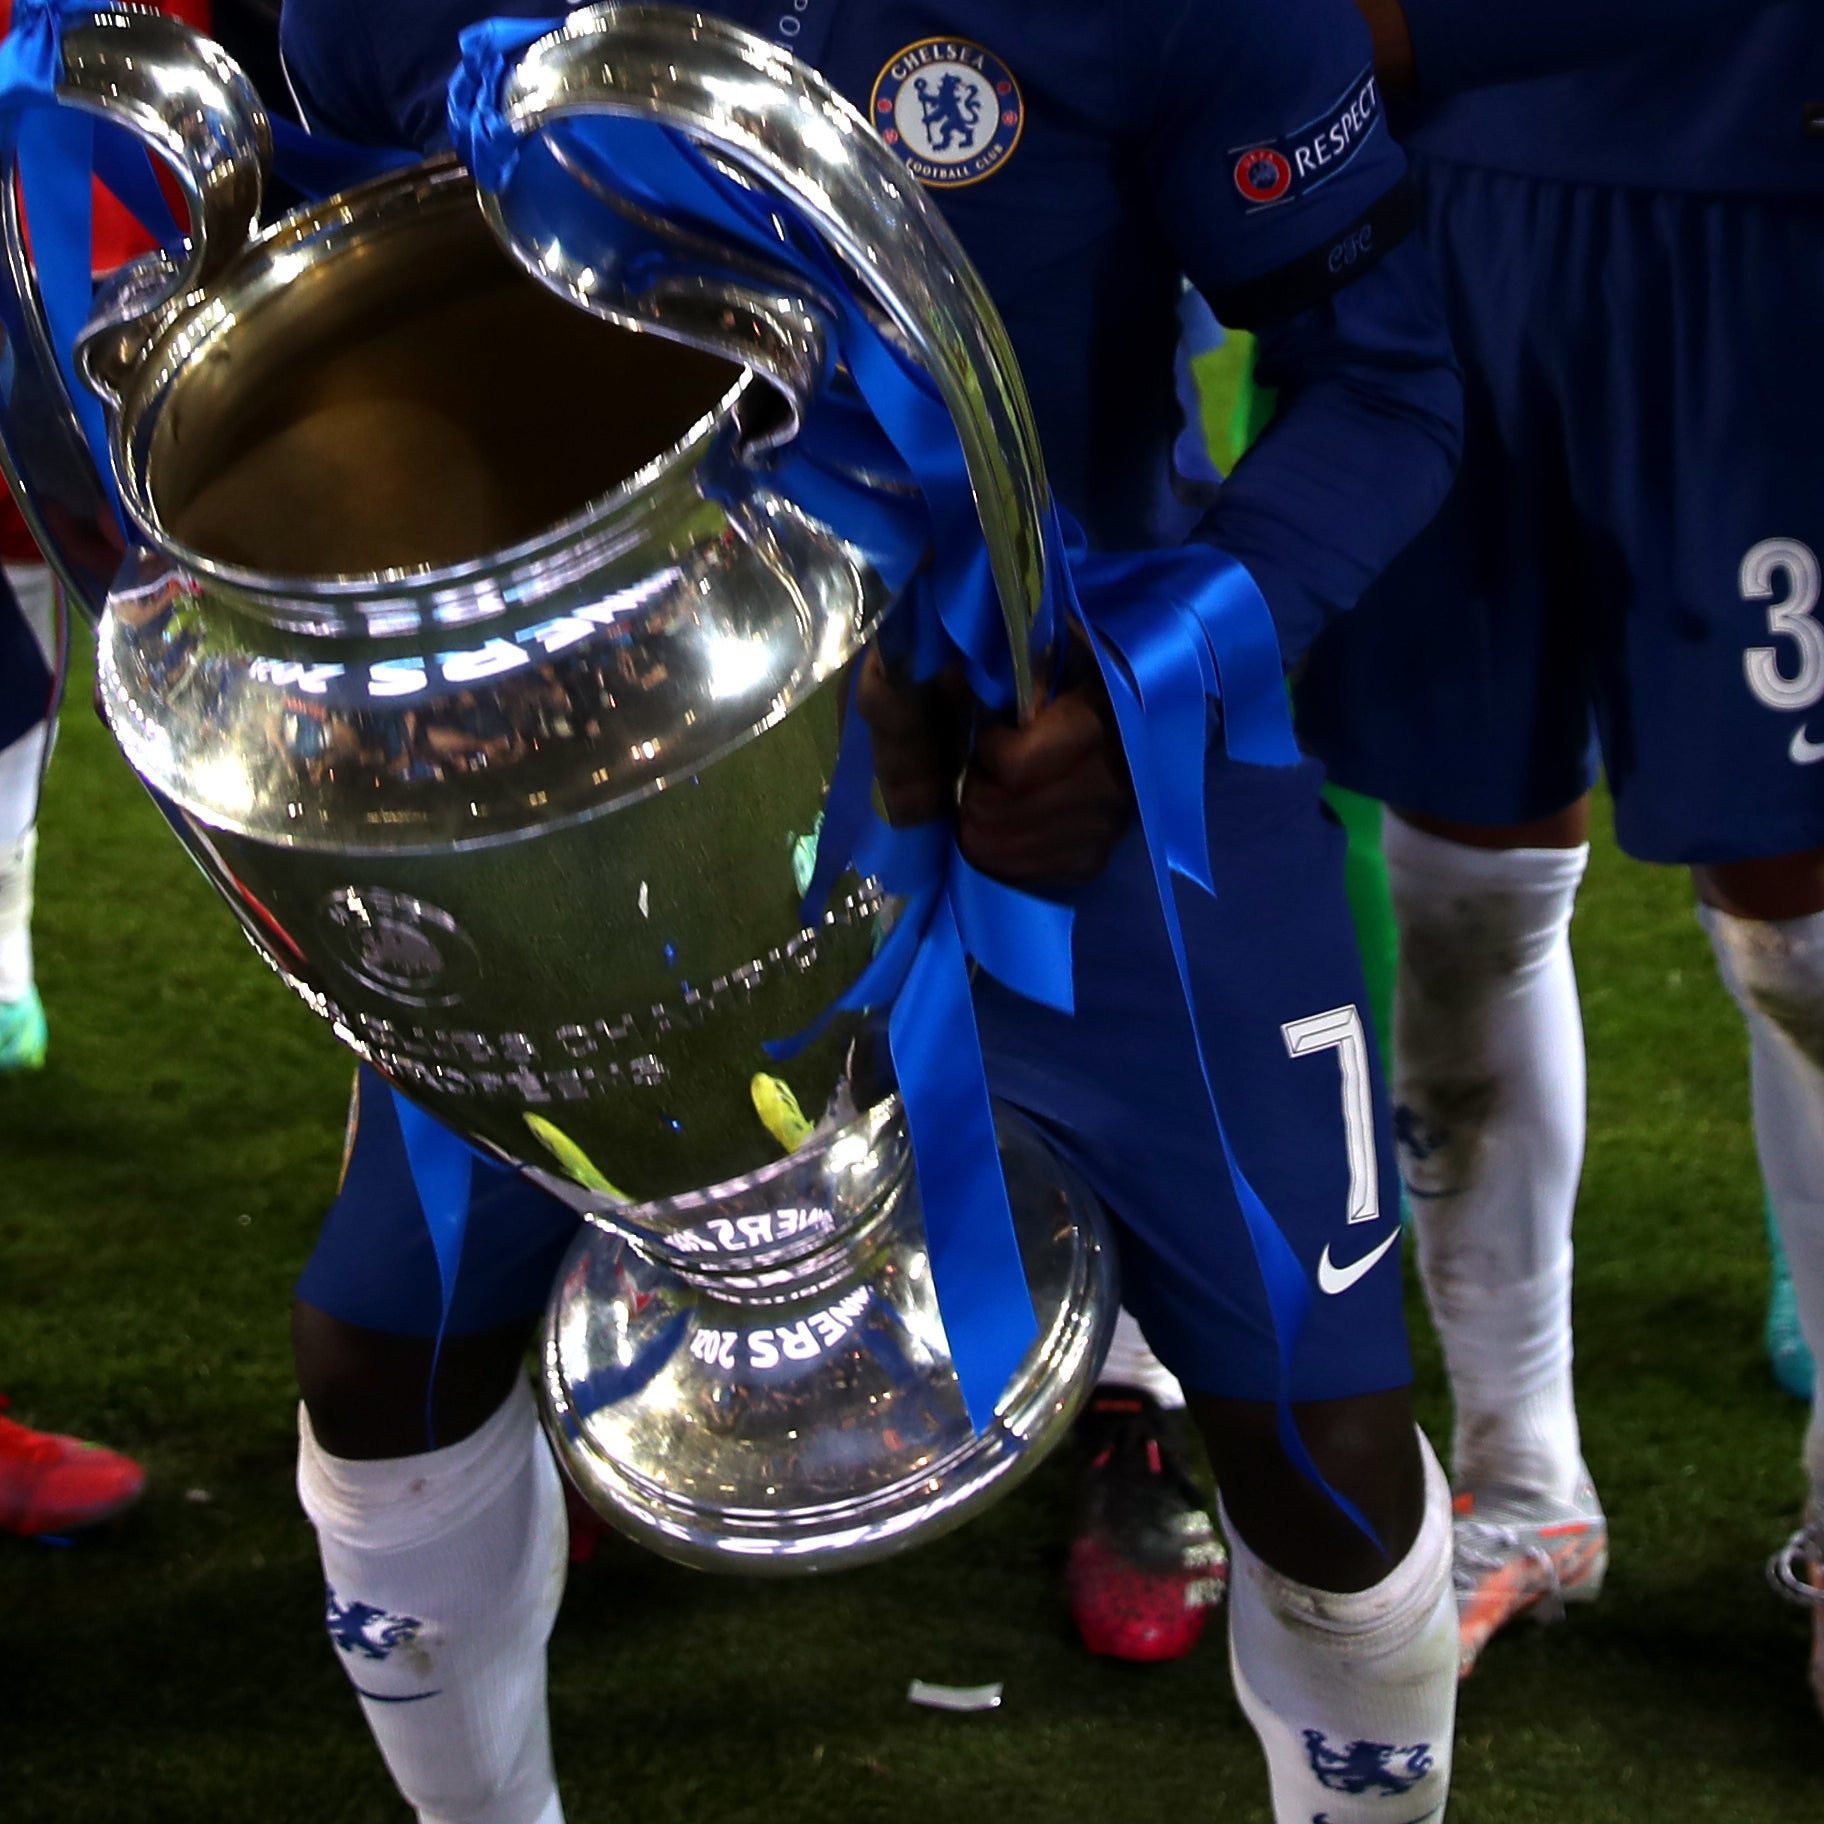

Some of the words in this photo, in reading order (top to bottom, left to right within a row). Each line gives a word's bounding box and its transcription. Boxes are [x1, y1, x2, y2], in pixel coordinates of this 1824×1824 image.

[890, 43, 985, 81] CHELSEA
[905, 156, 972, 180] FOOTBALL
[975, 142, 1005, 170] CLUB
[1293, 74, 1377, 178] RESPECT
[1279, 1002, 1381, 1226] 7
